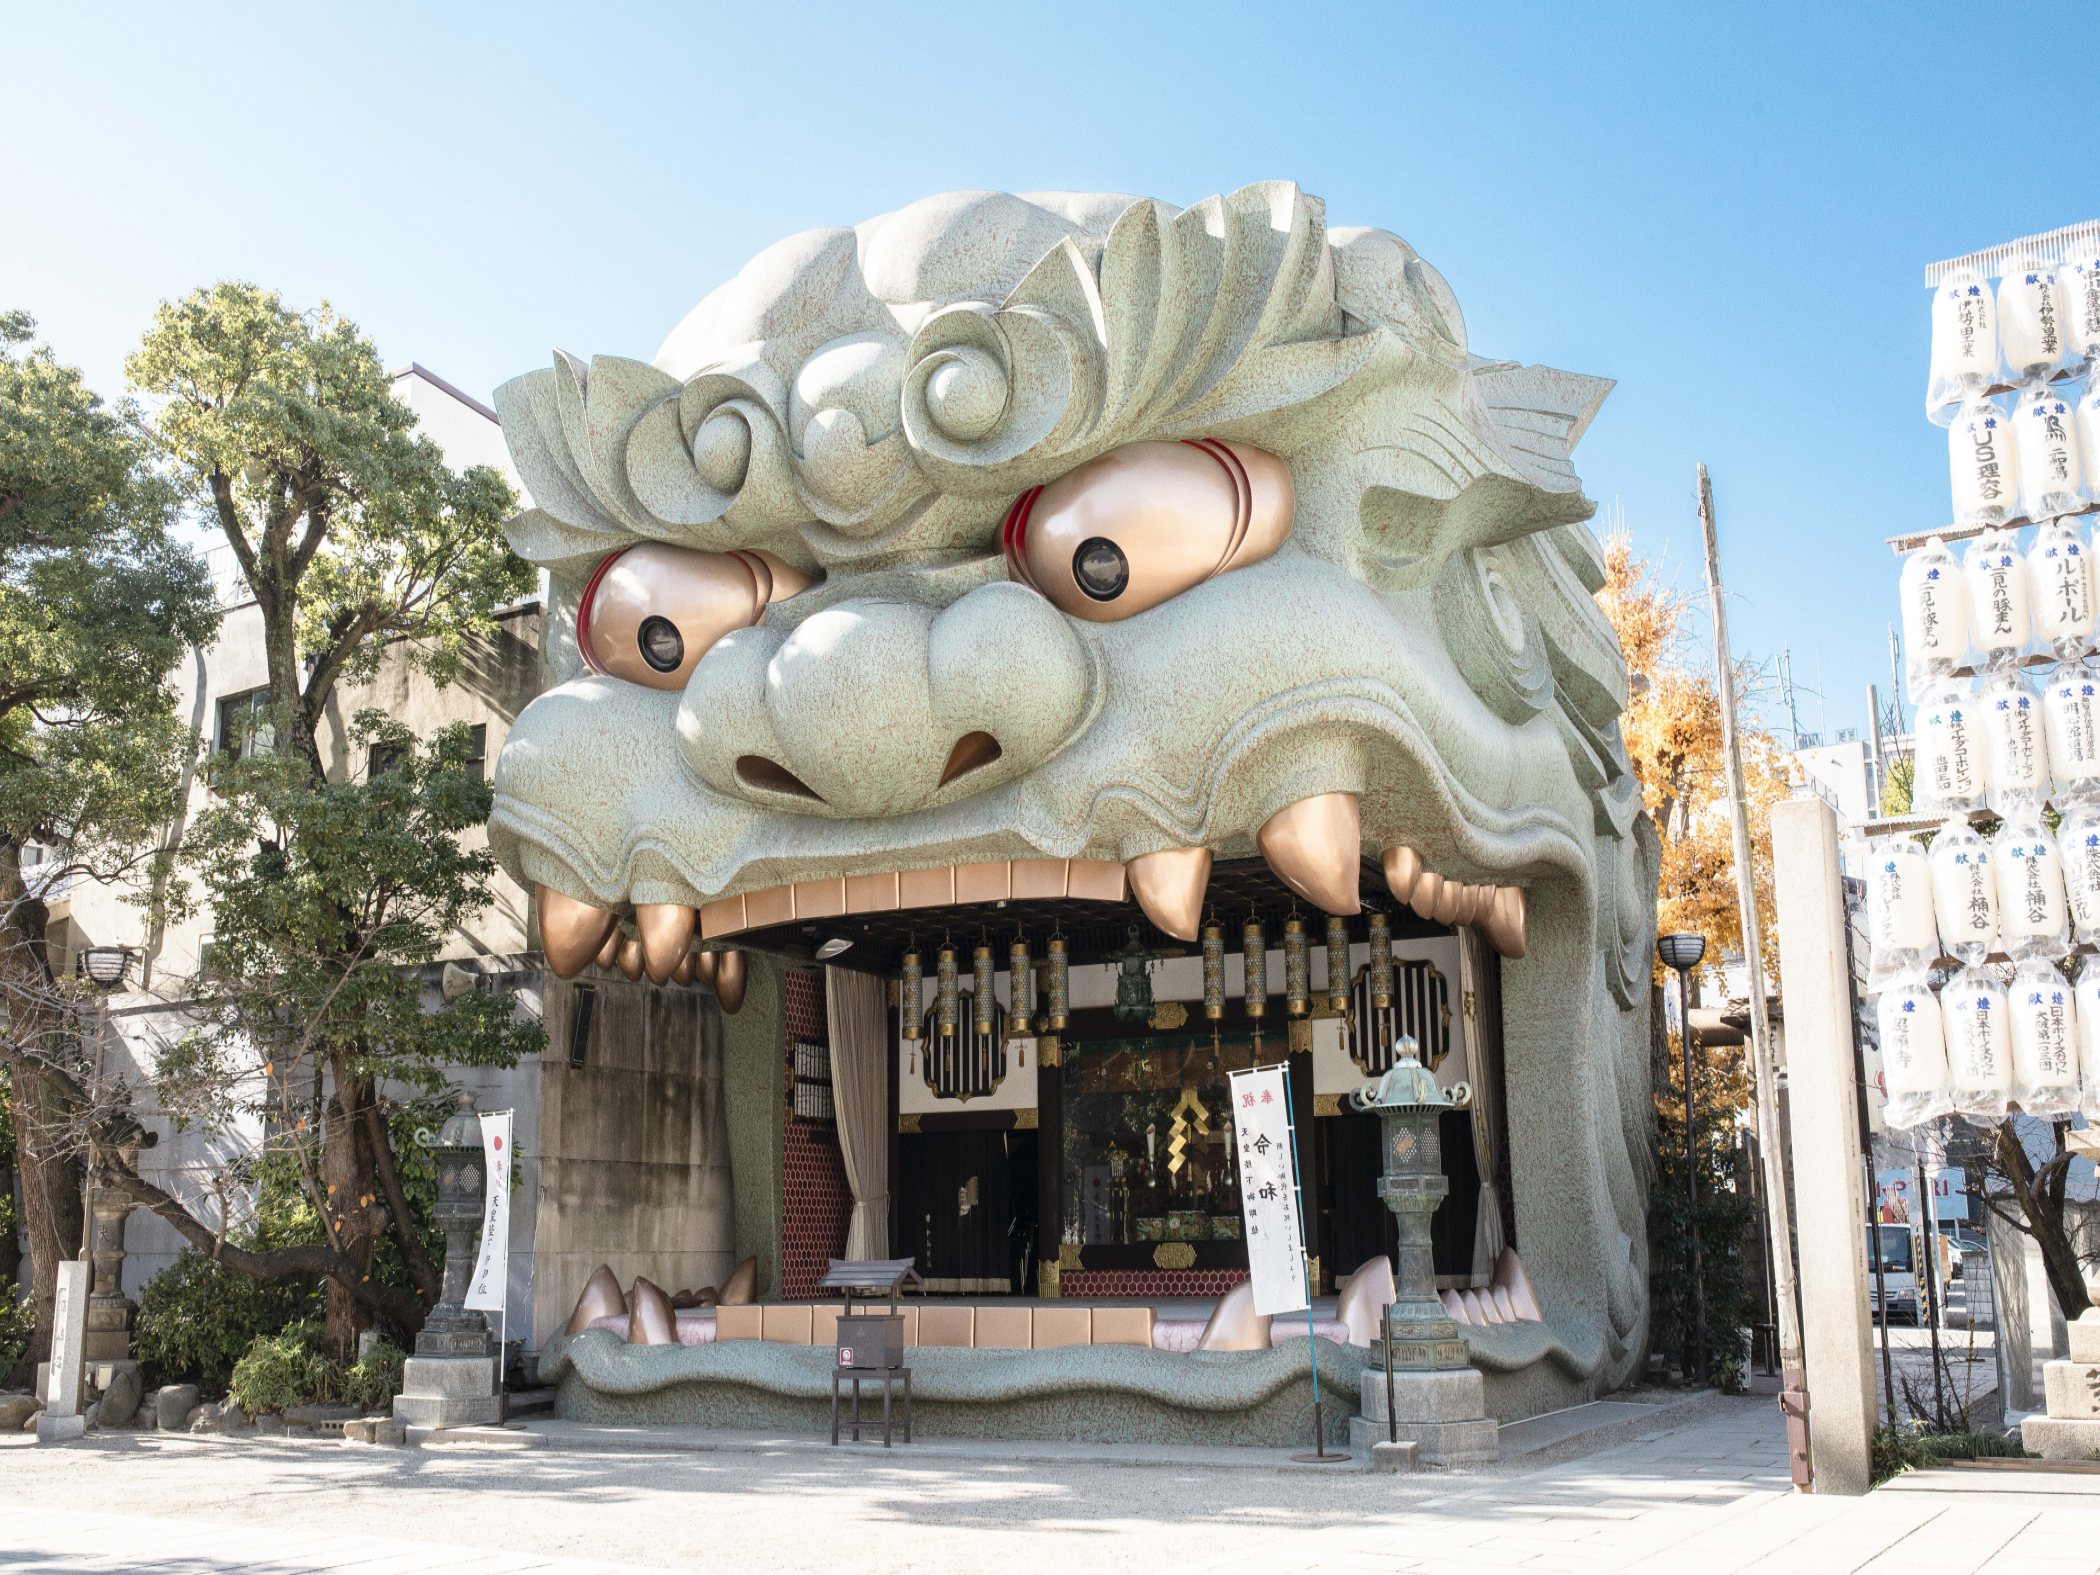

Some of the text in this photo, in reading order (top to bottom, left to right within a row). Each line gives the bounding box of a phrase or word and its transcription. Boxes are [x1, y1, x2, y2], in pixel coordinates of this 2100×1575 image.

[1972, 430, 2004, 500] US理容
[1917, 581, 1940, 650] 二見の豚まん
[1988, 567, 2014, 636] 二見の豚まん
[1967, 862, 1991, 930] 株式会社桶谷
[2023, 855, 2049, 924] 株式会社桶谷
[2028, 991, 2065, 1006] 献燈
[1975, 1010, 1996, 1080] 日本ボーイスカウト
[2049, 1005, 2068, 1076] 日本ボーイスカウト
